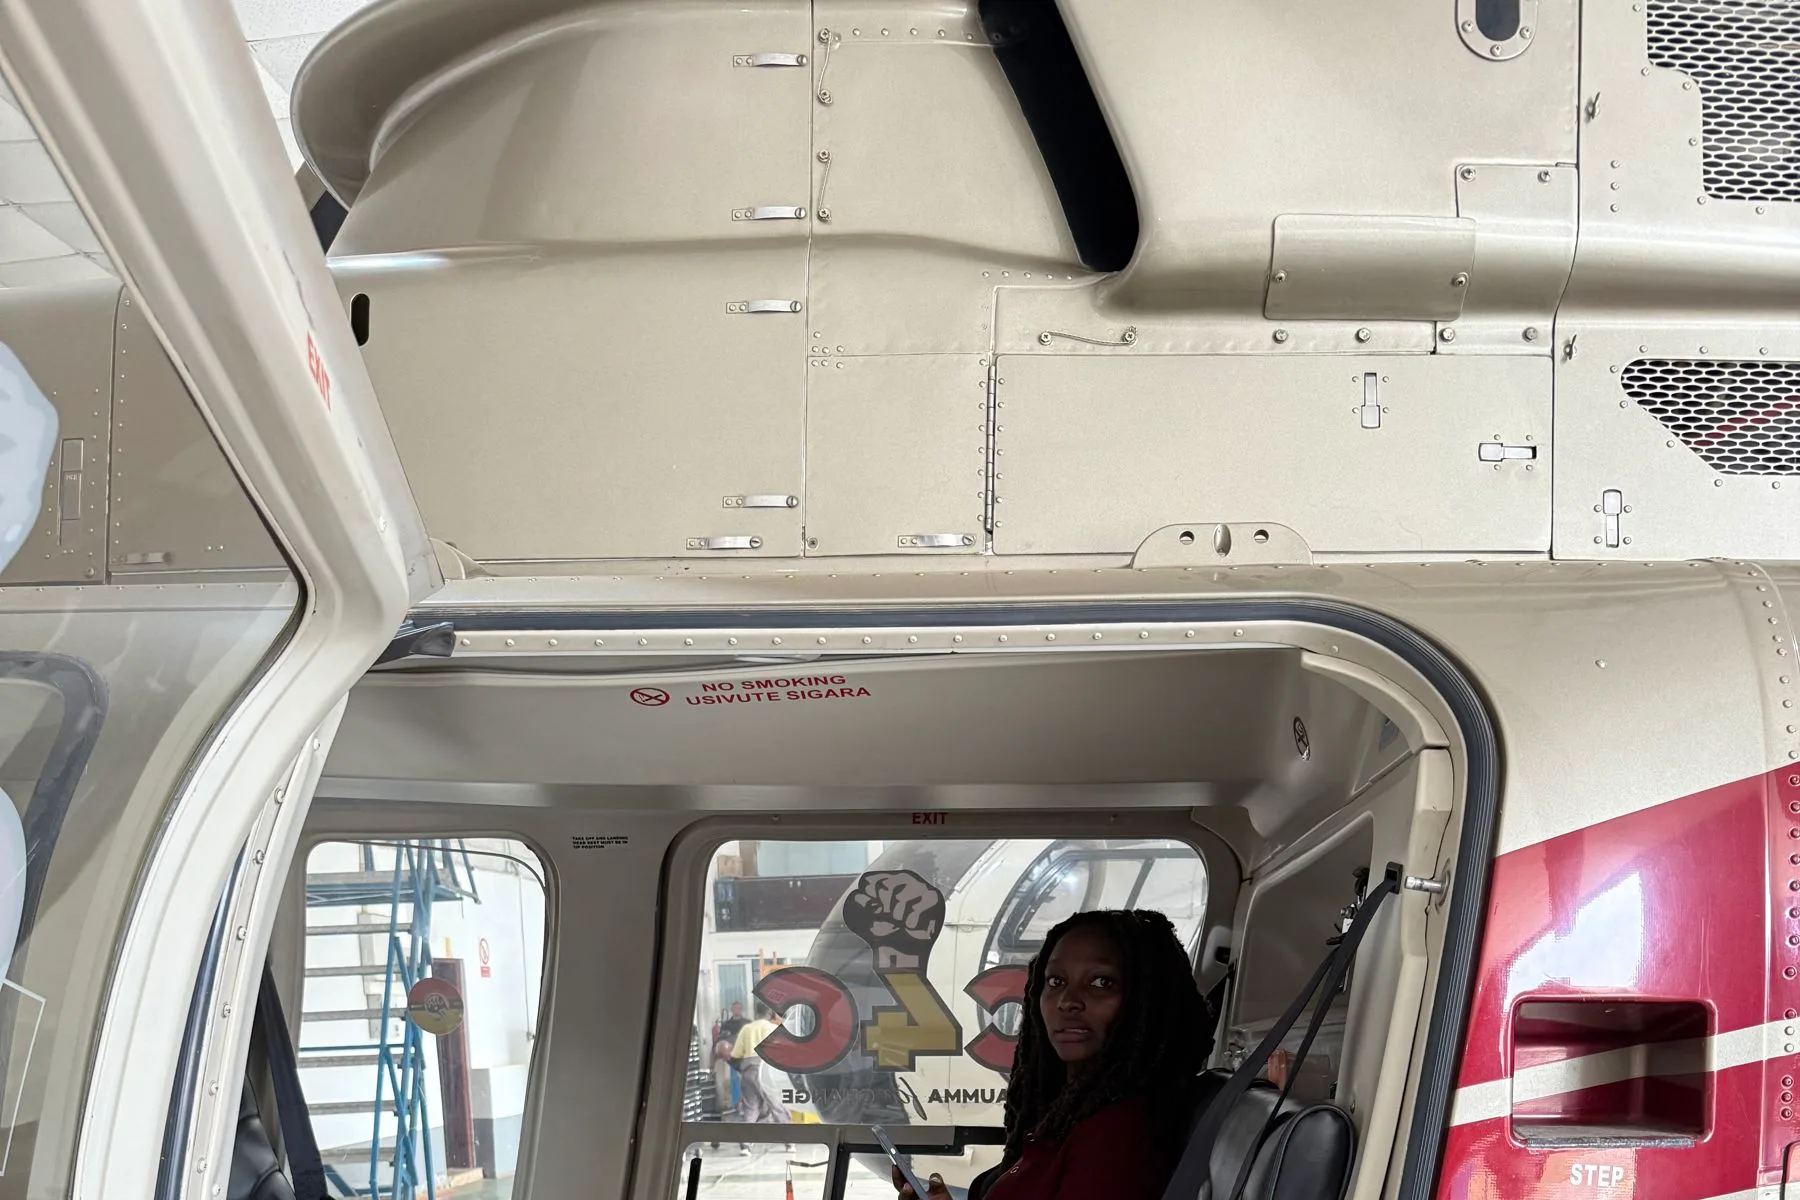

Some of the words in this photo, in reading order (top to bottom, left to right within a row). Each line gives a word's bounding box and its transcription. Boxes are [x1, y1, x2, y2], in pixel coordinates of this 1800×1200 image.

[306, 330, 331, 411] EXIT
[701, 682, 734, 692] NO
[742, 675, 846, 689] SMOKING
[686, 691, 781, 705] USIVUTE
[787, 686, 871, 700] SIGARA
[912, 811, 949, 824] EXIT
[1571, 1163, 1624, 1187] STEP
